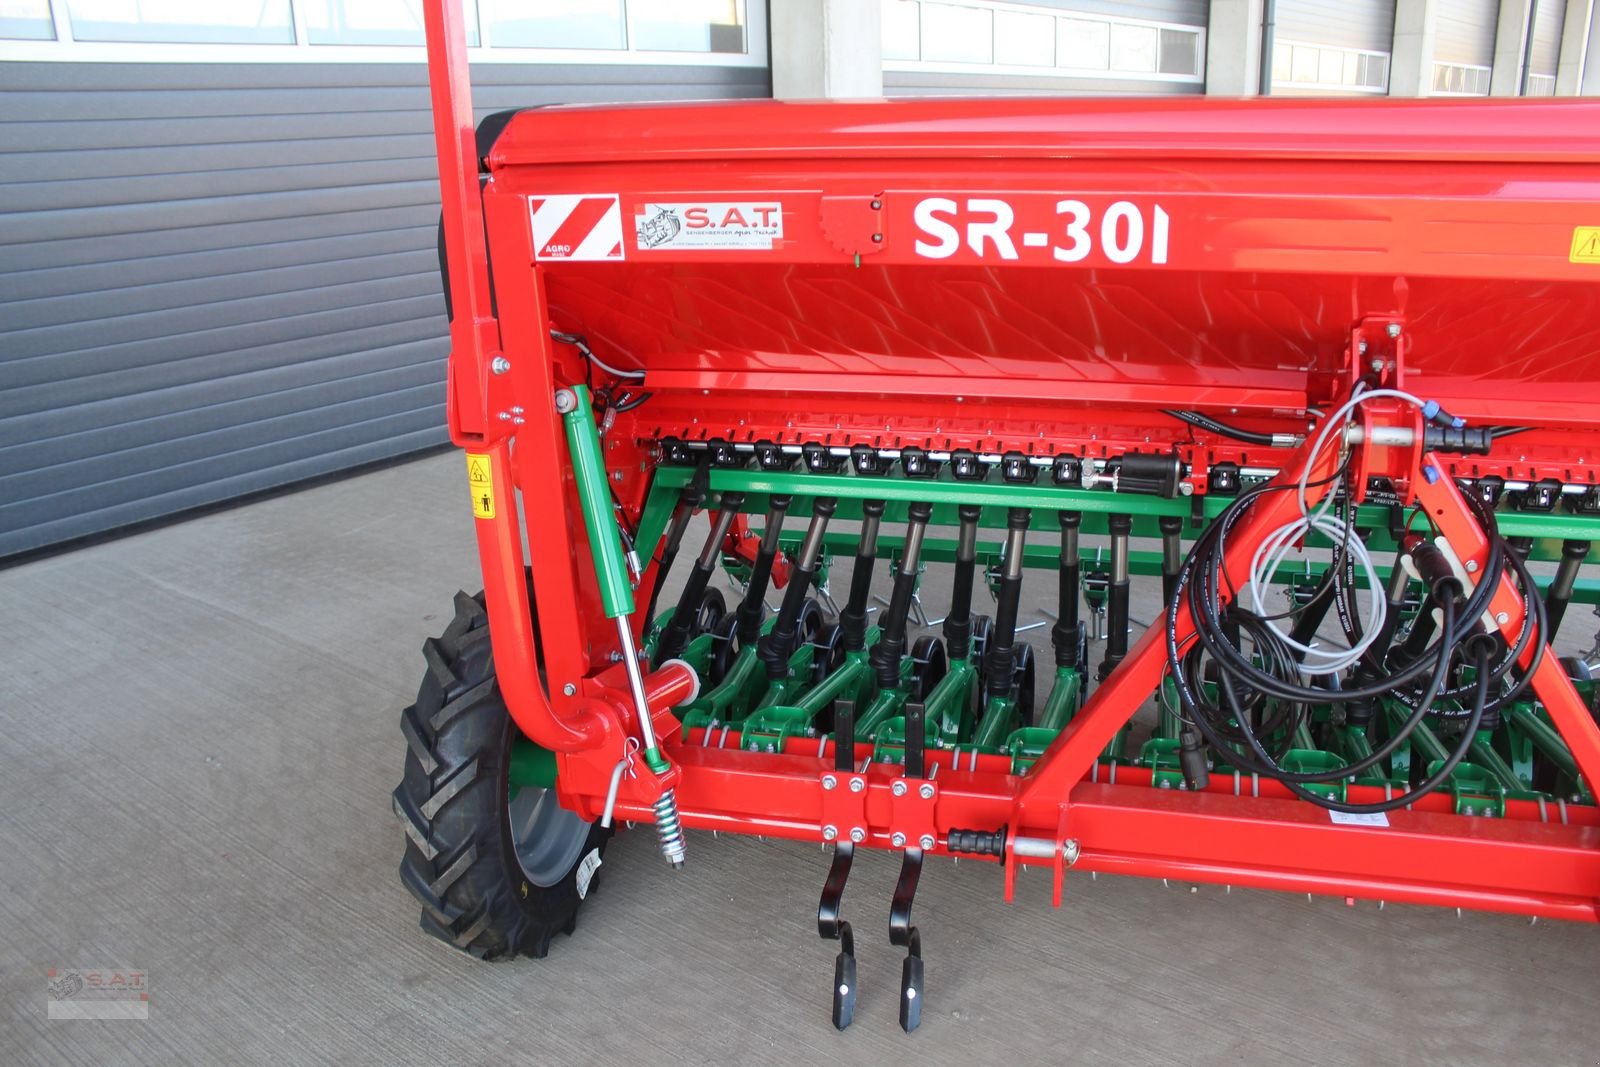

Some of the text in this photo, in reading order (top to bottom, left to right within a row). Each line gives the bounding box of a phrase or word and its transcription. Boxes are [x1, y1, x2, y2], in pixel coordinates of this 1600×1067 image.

[684, 207, 778, 229] S.A.T.
[913, 197, 1170, 264] SR-301
[545, 244, 570, 253] AGRO
